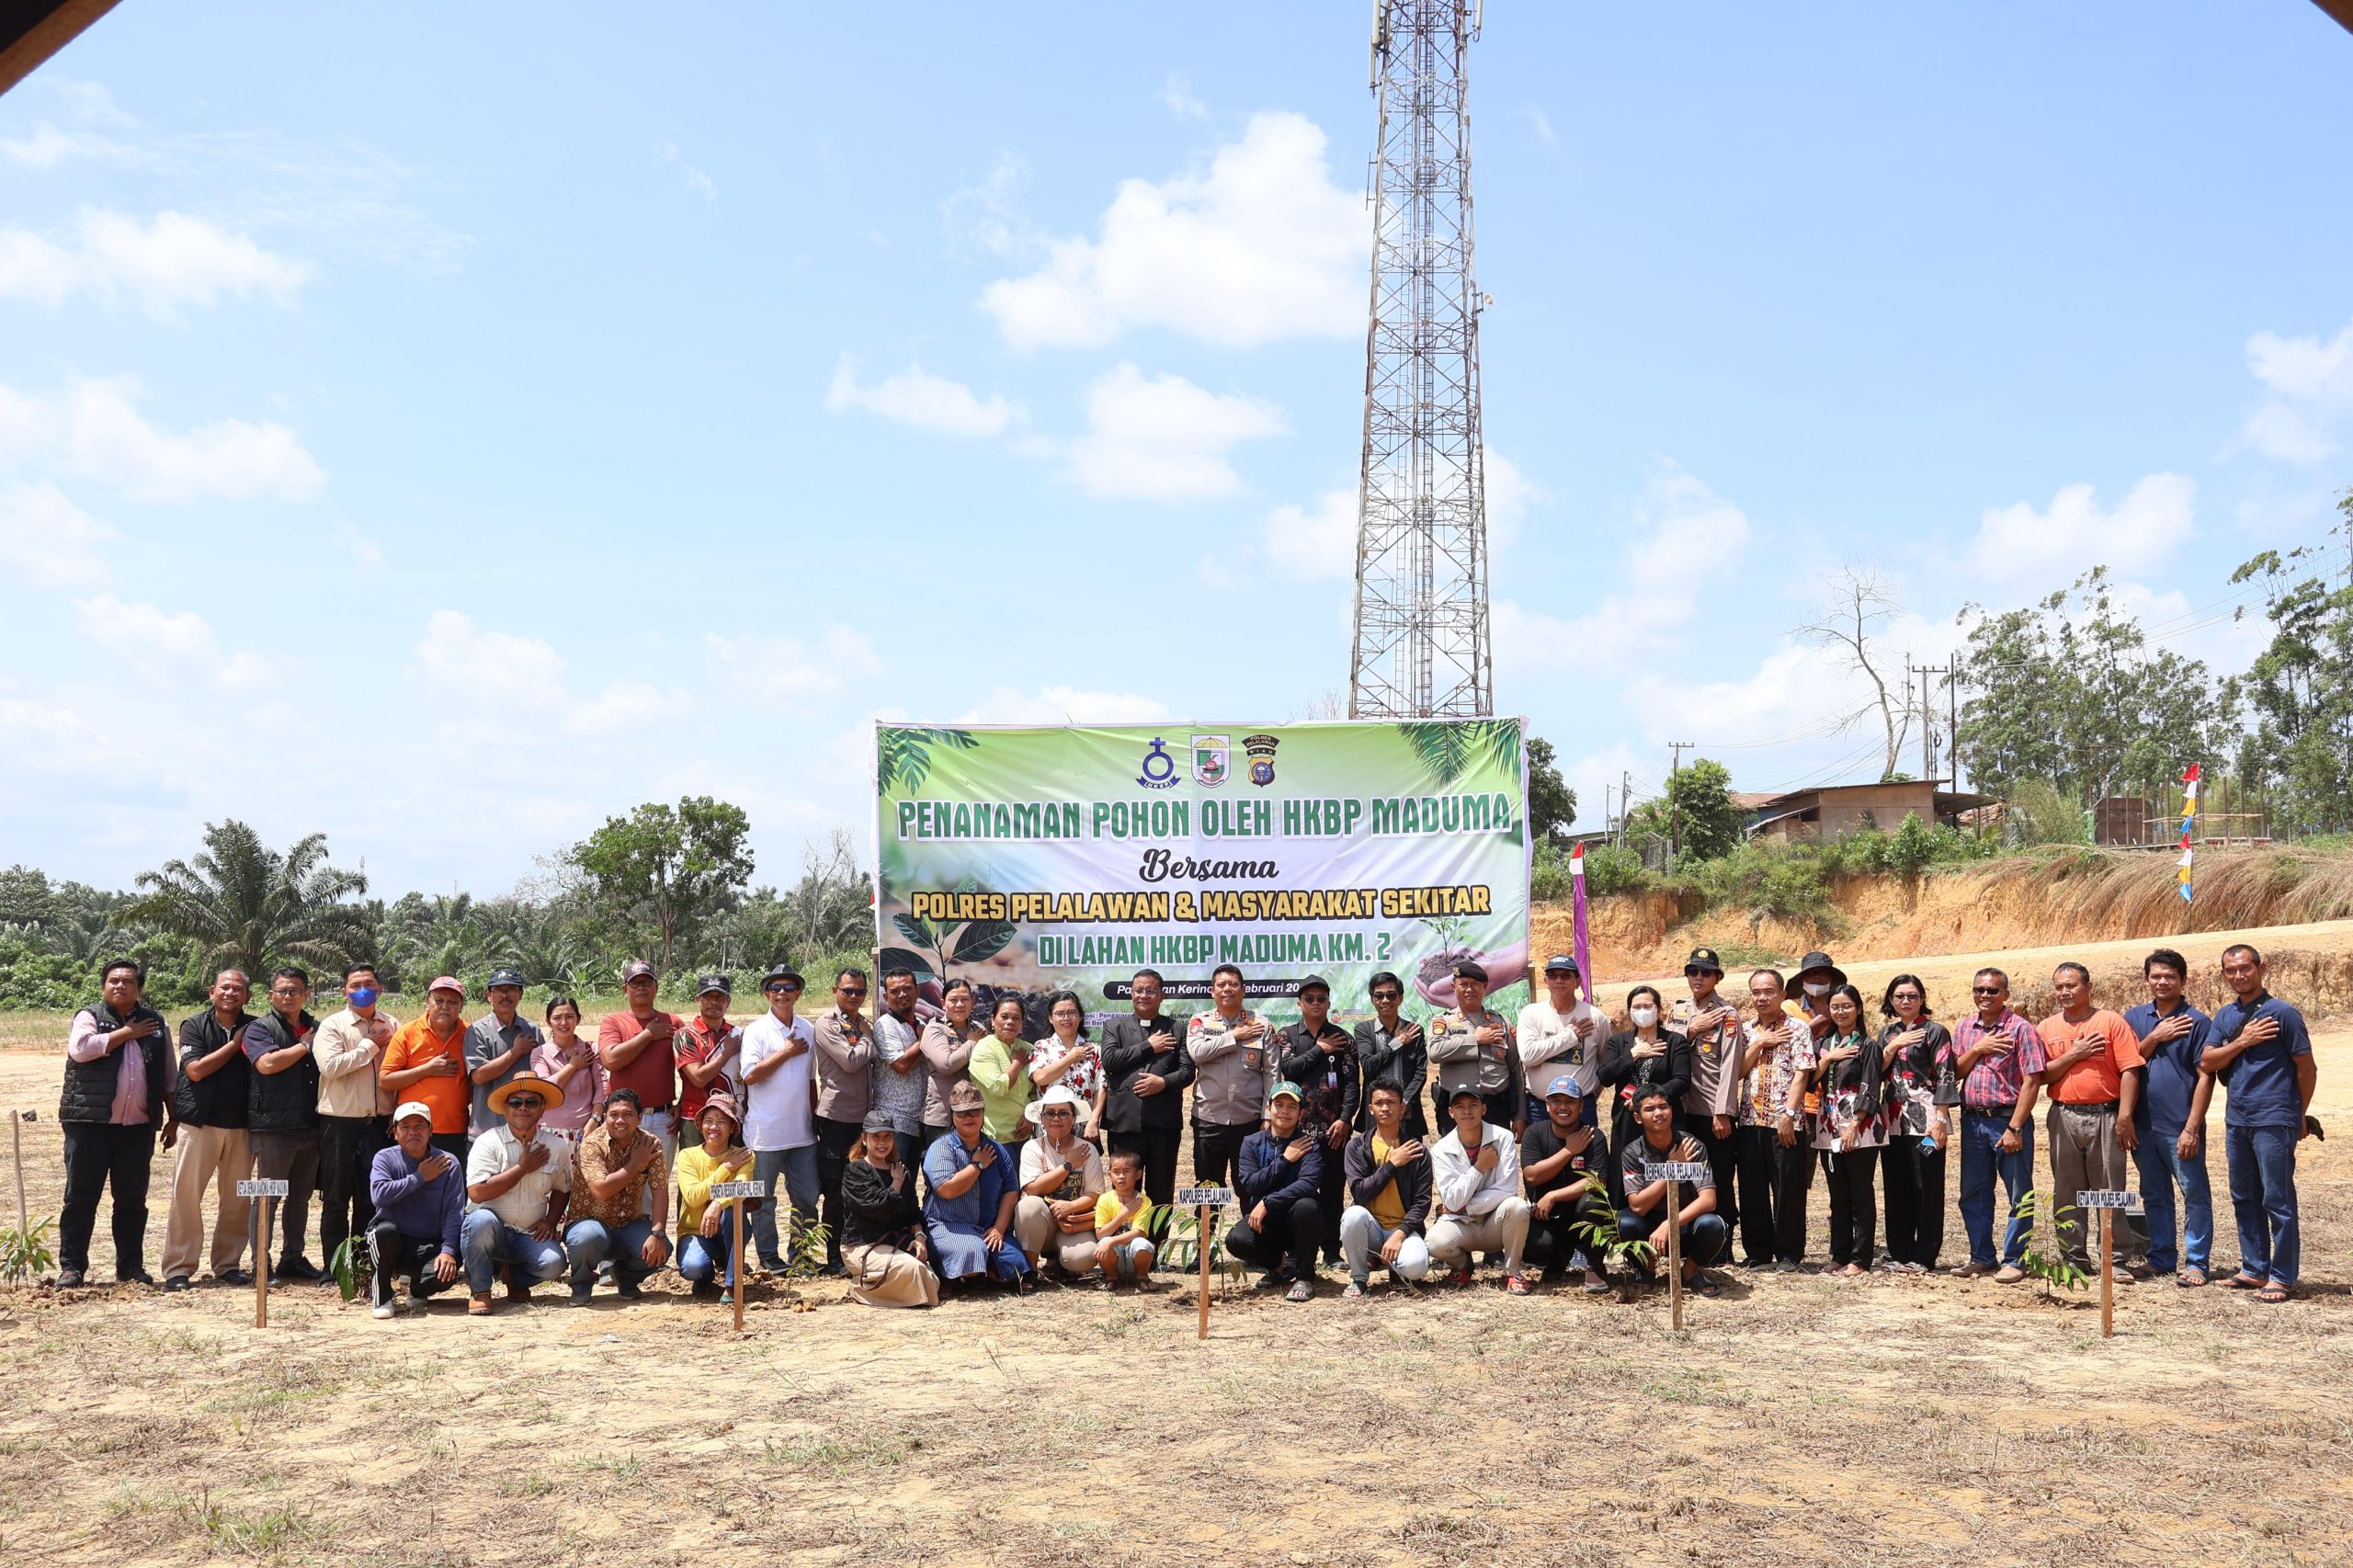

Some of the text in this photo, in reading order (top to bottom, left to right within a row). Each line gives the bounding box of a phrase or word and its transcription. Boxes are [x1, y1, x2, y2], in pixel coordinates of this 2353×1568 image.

[1147, 780, 1171, 789] HKBP
[898, 792, 1513, 839] PENANAMAN POHON OLEH HKBP MADUMA
[1139, 847, 1279, 883] Bersama
[912, 884, 1492, 923] POLRES PELALAWAN & MASYARAKAT SEKITAR
[1039, 932, 1391, 965] DI LAHAN HKBP MADUMA KM. 2
[1177, 984, 1213, 994] Kerinc
[1244, 983, 1284, 994] ebruari
[1285, 983, 1300, 993] 20
[1645, 1164, 1665, 1180] KEMENAG
[1677, 1163, 1702, 1179] PELALAWAN
[1179, 1188, 1232, 1204] KAPOLRES PELALAWAN
[2115, 1192, 2137, 1207] PELALAWAN
